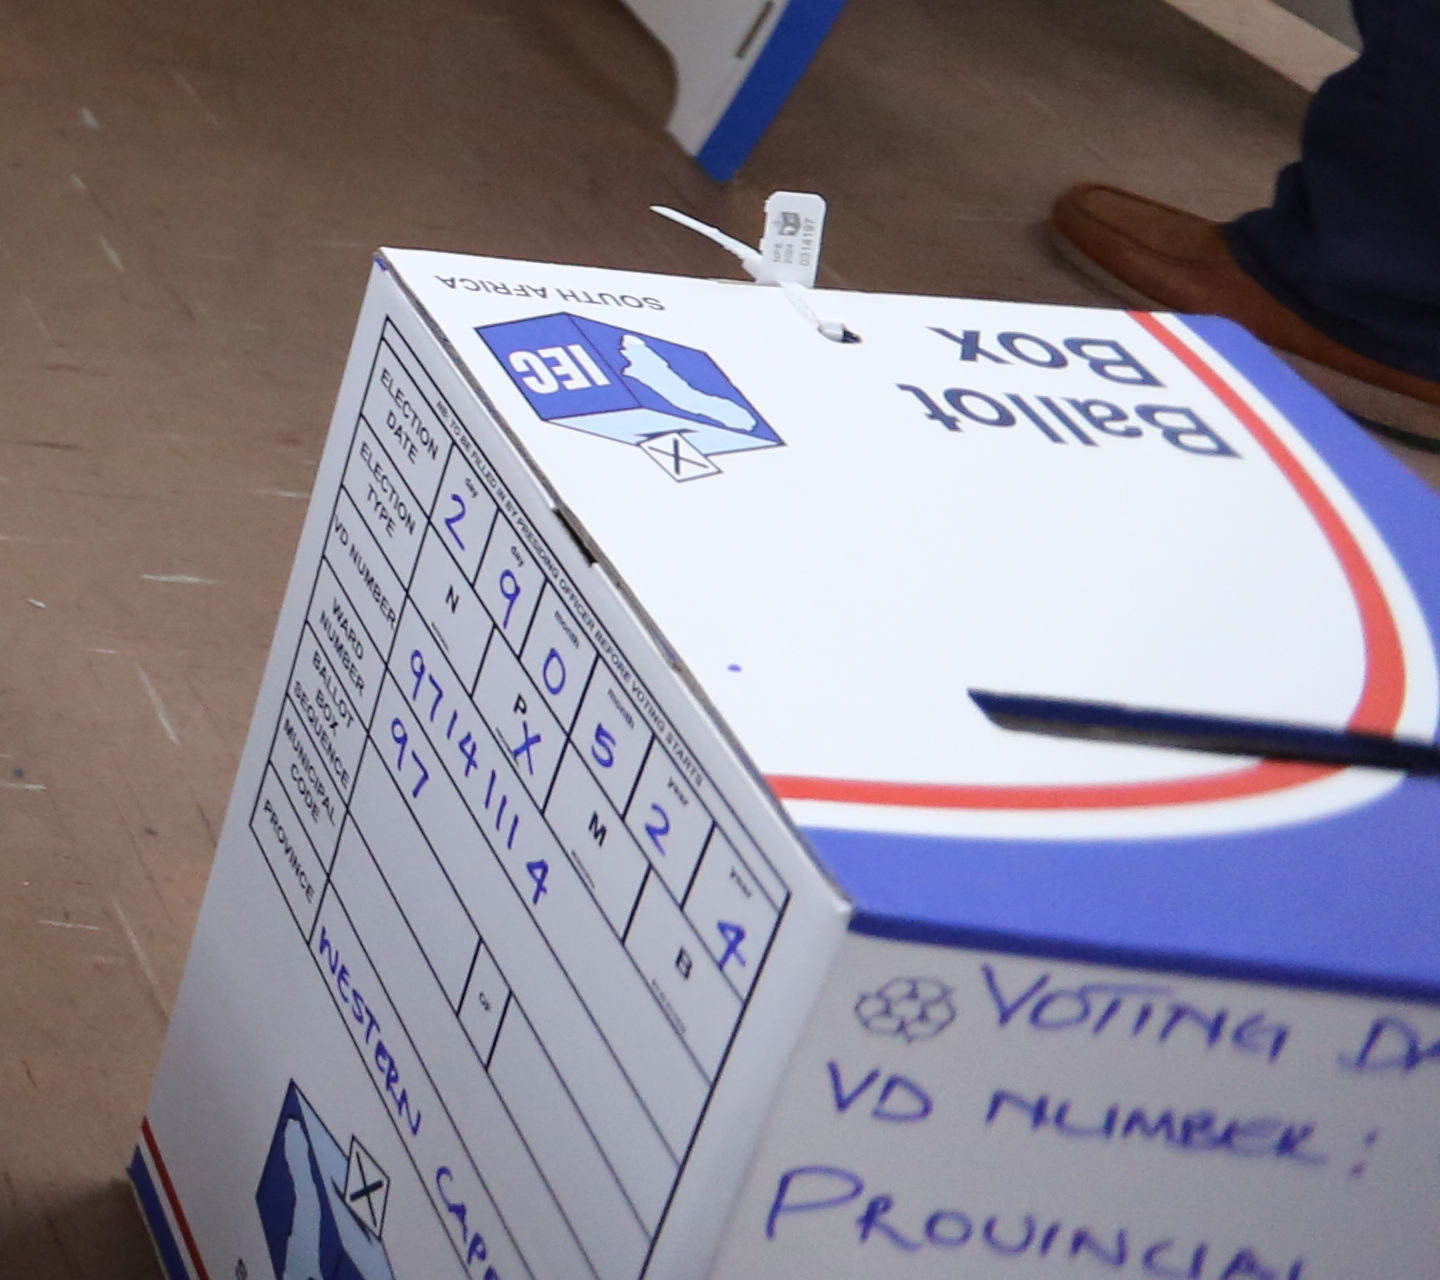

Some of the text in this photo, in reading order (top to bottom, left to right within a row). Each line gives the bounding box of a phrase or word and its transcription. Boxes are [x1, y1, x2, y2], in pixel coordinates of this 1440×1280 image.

[435, 274, 665, 311] SOUTH AFRICA
[509, 344, 611, 394] IEC
[927, 326, 1167, 389] Box
[380, 367, 440, 460] ELECTION
[386, 409, 419, 464] DATE
[899, 383, 1247, 459] Ballot
[359, 442, 417, 536] ELECTION
[367, 484, 396, 538] TYPE
[334, 515, 398, 630] VD NUMBER
[320, 609, 365, 697] NUMBER
[332, 597, 365, 661] WARD
[312, 650, 355, 728] BALLOT
[315, 688, 339, 737] BOX
[283, 718, 336, 827] MUNICIPAL
[294, 680, 350, 791] SEQUENCE
[391, 717, 429, 799] 97
[290, 762, 320, 823] CODE
[263, 798, 315, 904] PROVINCE
[318, 926, 421, 1137] WESTERN
[981, 963, 1288, 1062] VOTING
[827, 1061, 934, 1124] VD
